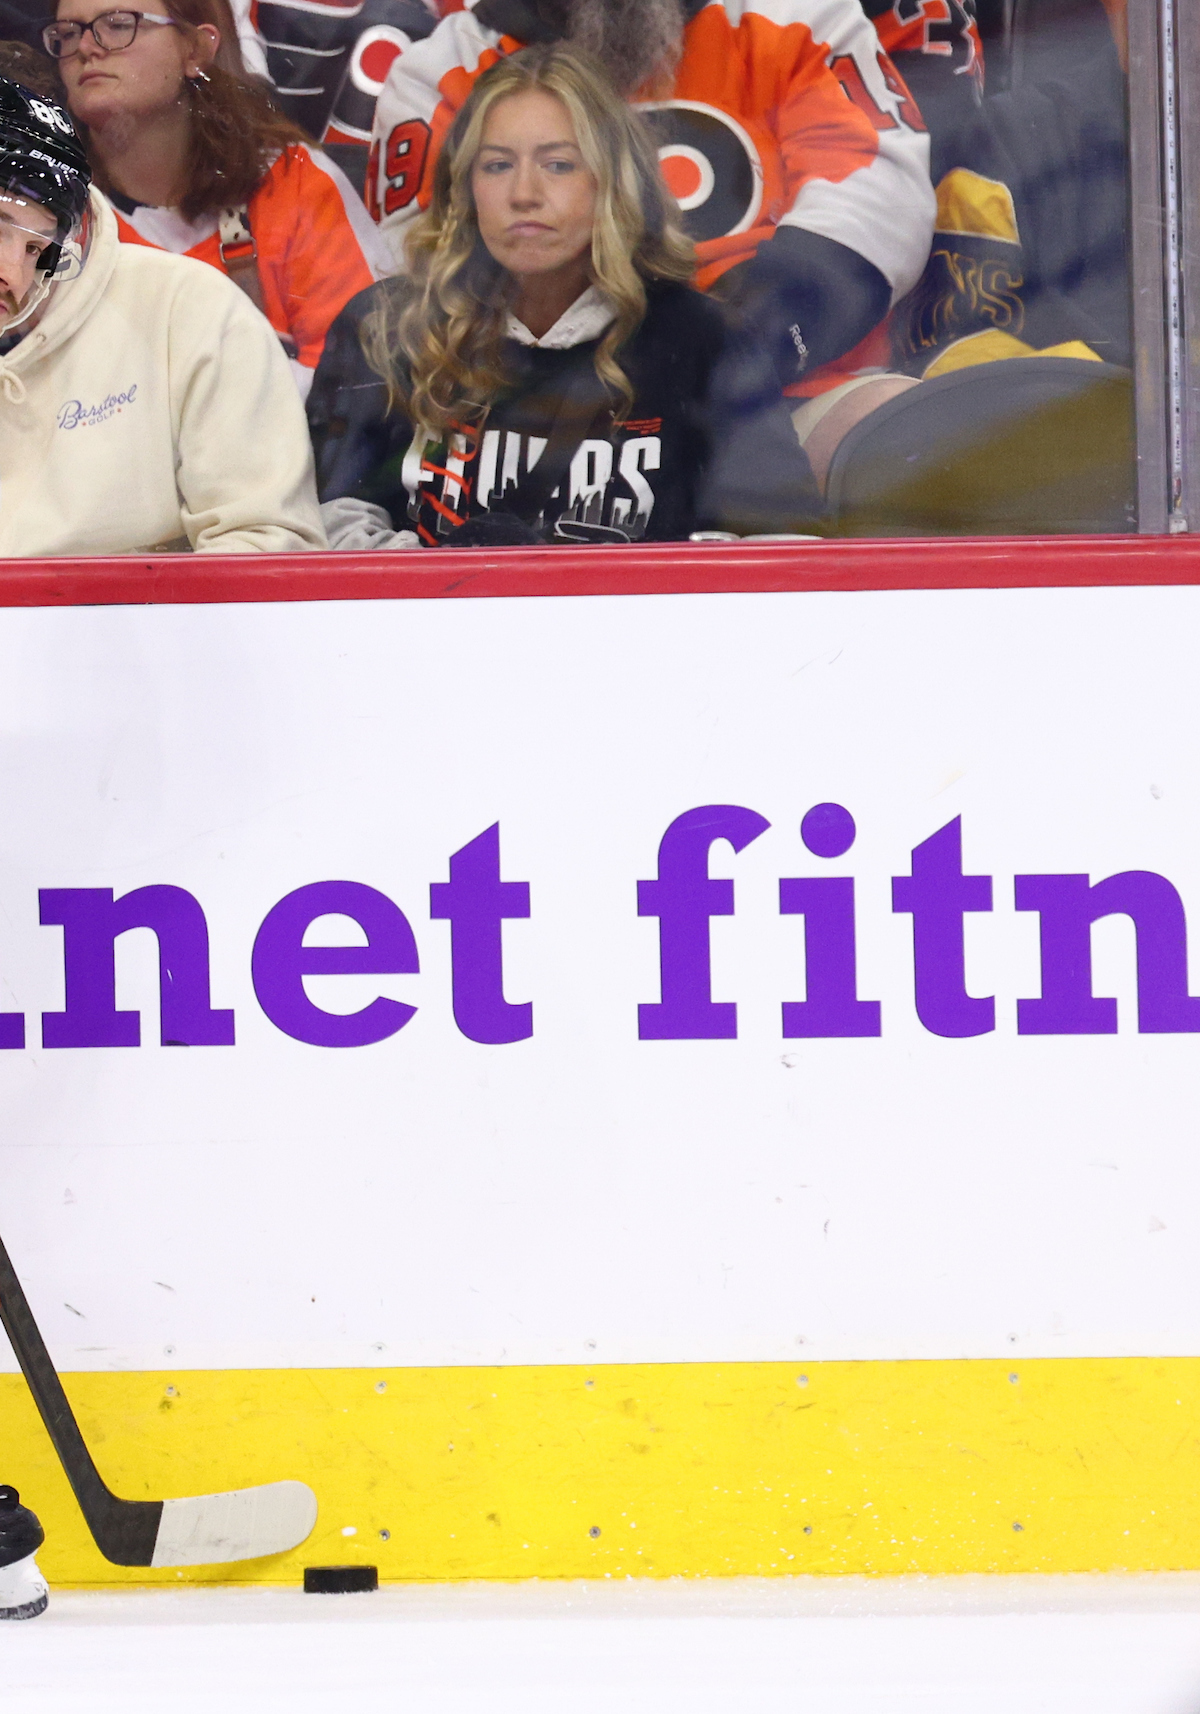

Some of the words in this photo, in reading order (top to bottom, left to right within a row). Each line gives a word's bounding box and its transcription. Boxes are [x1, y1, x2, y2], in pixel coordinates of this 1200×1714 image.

[29, 99, 71, 134] 86
[56, 383, 138, 430] Barstool
[637, 802, 1200, 1041] fitn
